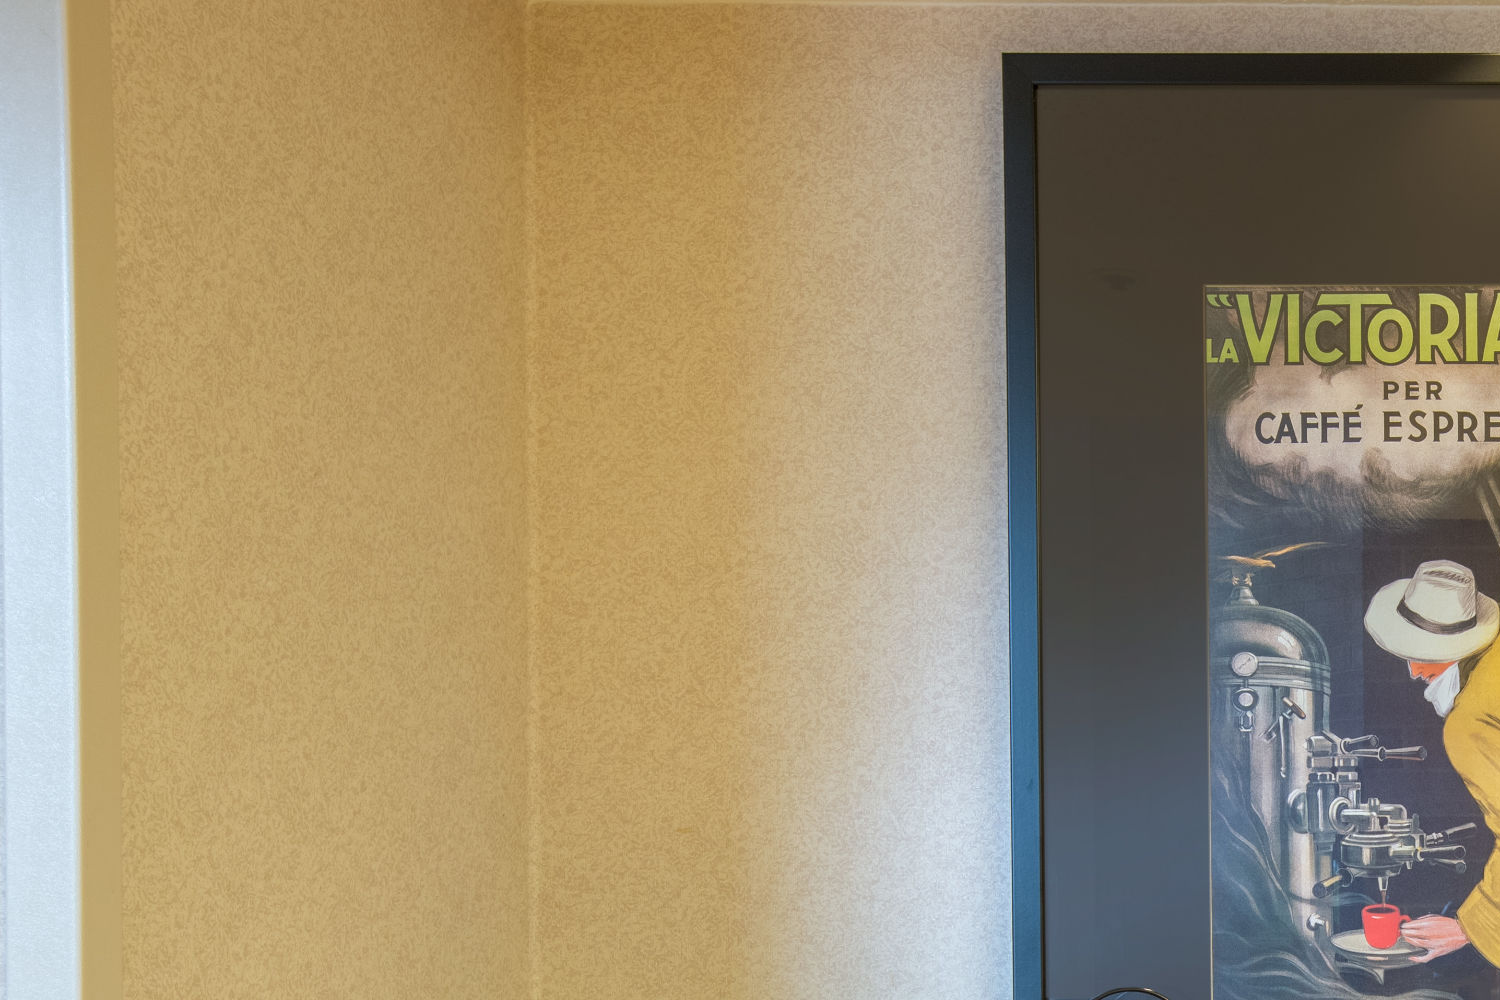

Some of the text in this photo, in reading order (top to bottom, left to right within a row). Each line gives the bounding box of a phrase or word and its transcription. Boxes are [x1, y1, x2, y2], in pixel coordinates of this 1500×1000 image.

[1206, 338, 1239, 364] LA
[1383, 381, 1443, 401] PER
[1255, 404, 1363, 444] CAFFÉ
